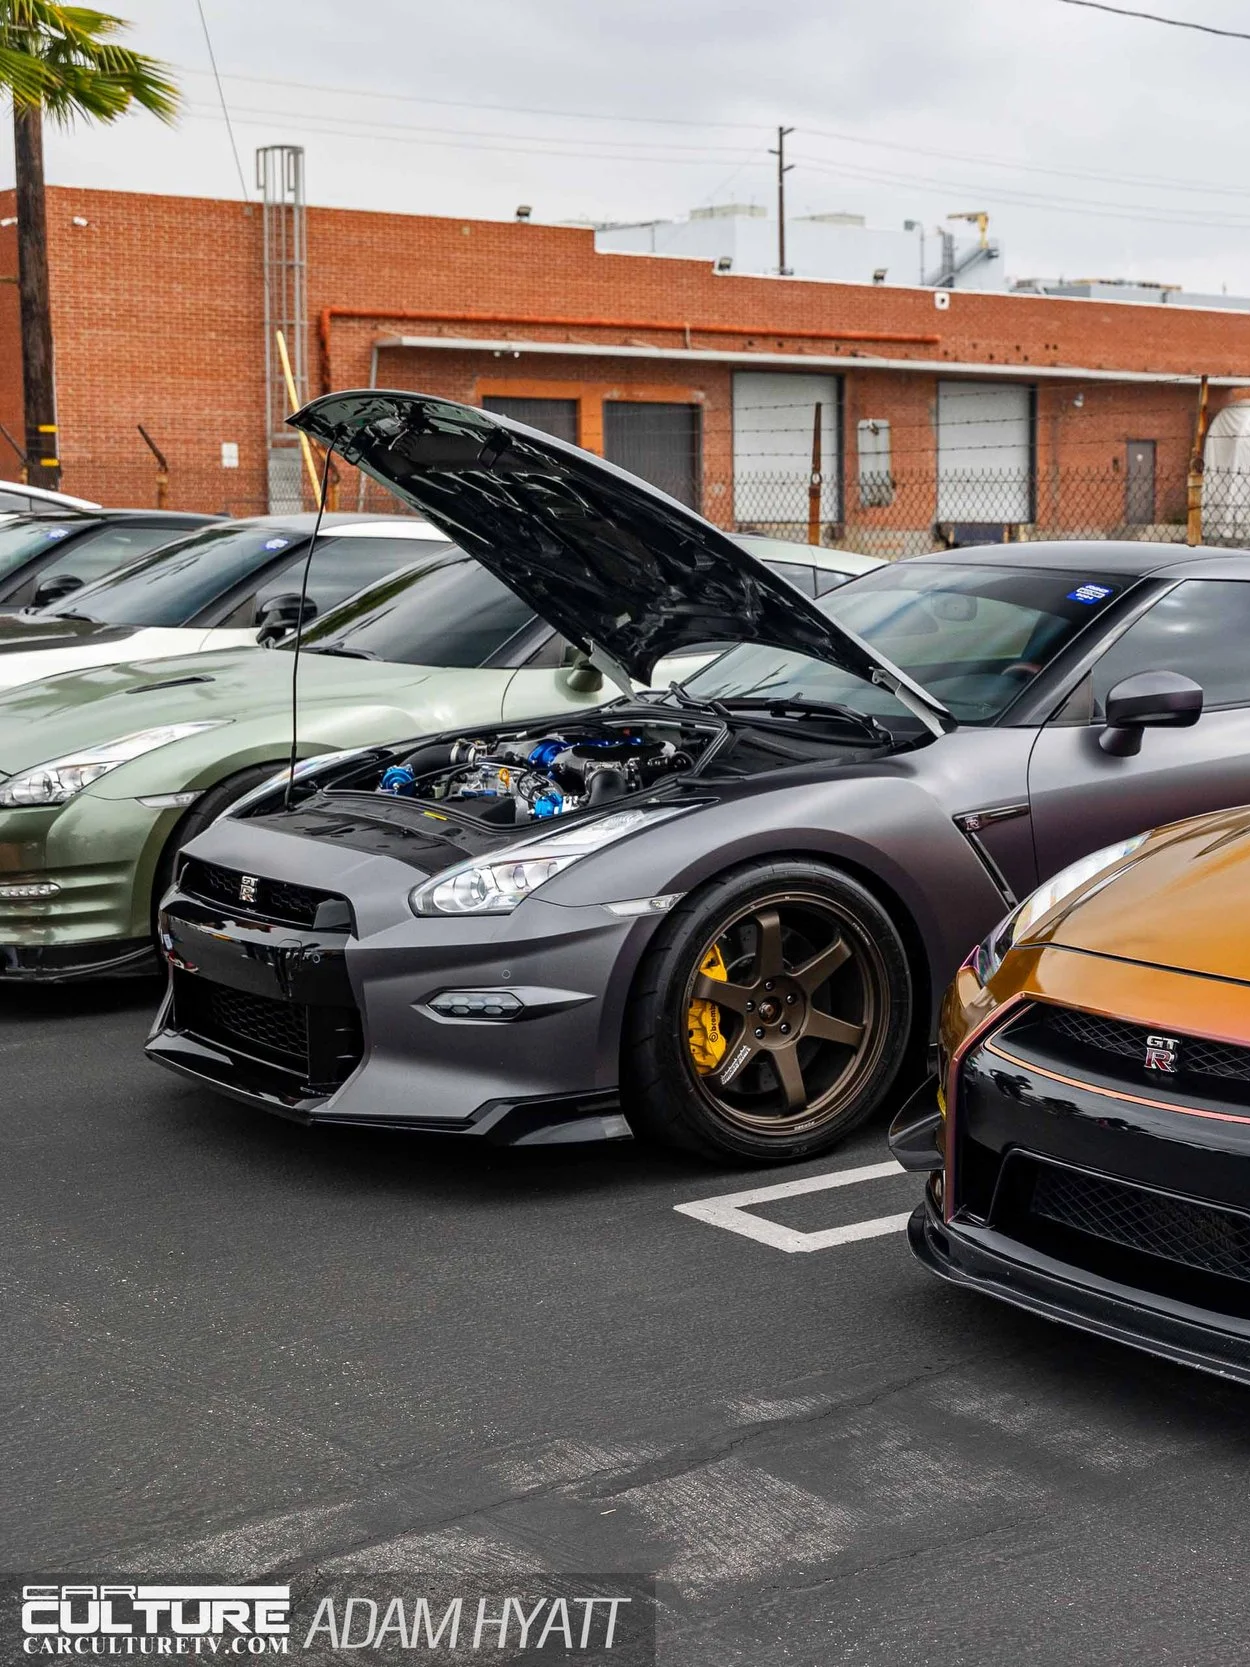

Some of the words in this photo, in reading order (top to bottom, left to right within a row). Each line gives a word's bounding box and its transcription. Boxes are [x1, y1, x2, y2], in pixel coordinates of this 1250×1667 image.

[708, 1003, 718, 1031] bremb
[1146, 1035, 1180, 1050] GT
[1143, 1047, 1178, 1073] R
